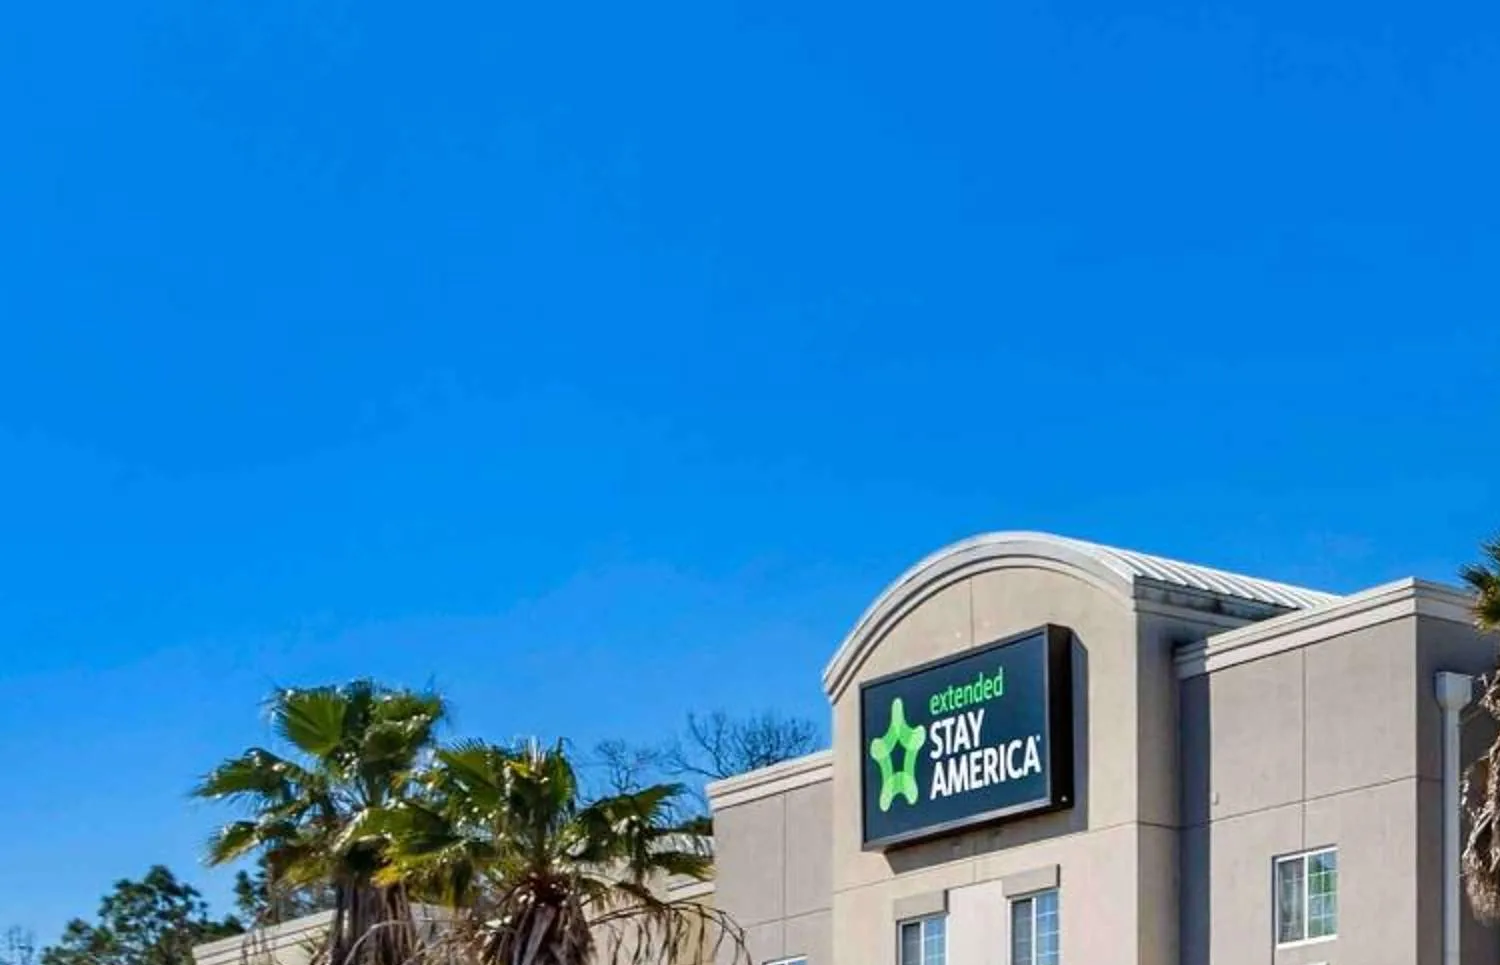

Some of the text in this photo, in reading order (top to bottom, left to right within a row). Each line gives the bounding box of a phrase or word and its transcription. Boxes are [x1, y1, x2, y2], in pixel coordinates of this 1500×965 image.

[929, 666, 1004, 716] extended
[930, 708, 985, 760] STAY
[929, 735, 1041, 800] AMERICA
